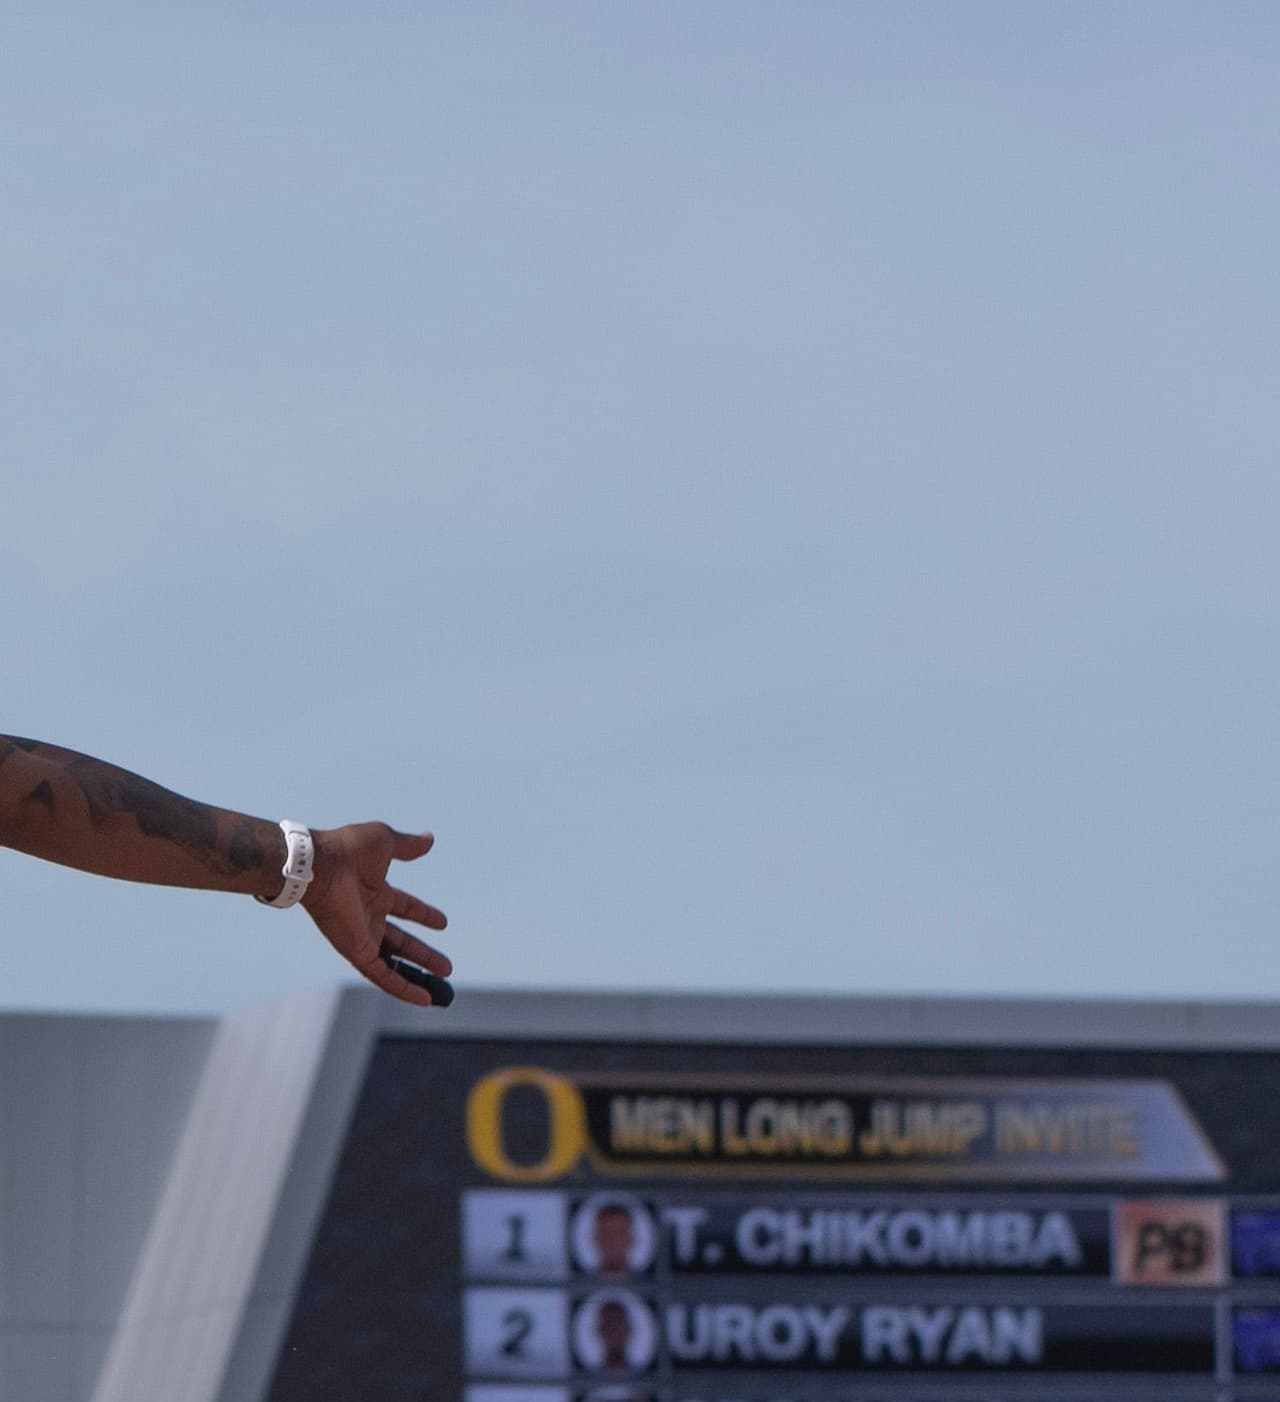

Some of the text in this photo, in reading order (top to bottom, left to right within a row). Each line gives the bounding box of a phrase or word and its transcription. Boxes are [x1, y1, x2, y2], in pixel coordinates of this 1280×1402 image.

[609, 1094, 1142, 1158] MEN LONG JUMP INVITE
[503, 1206, 1083, 1268] 1 T. CHIKOMBA
[499, 1304, 1043, 1364] 2 UROY RYAN
